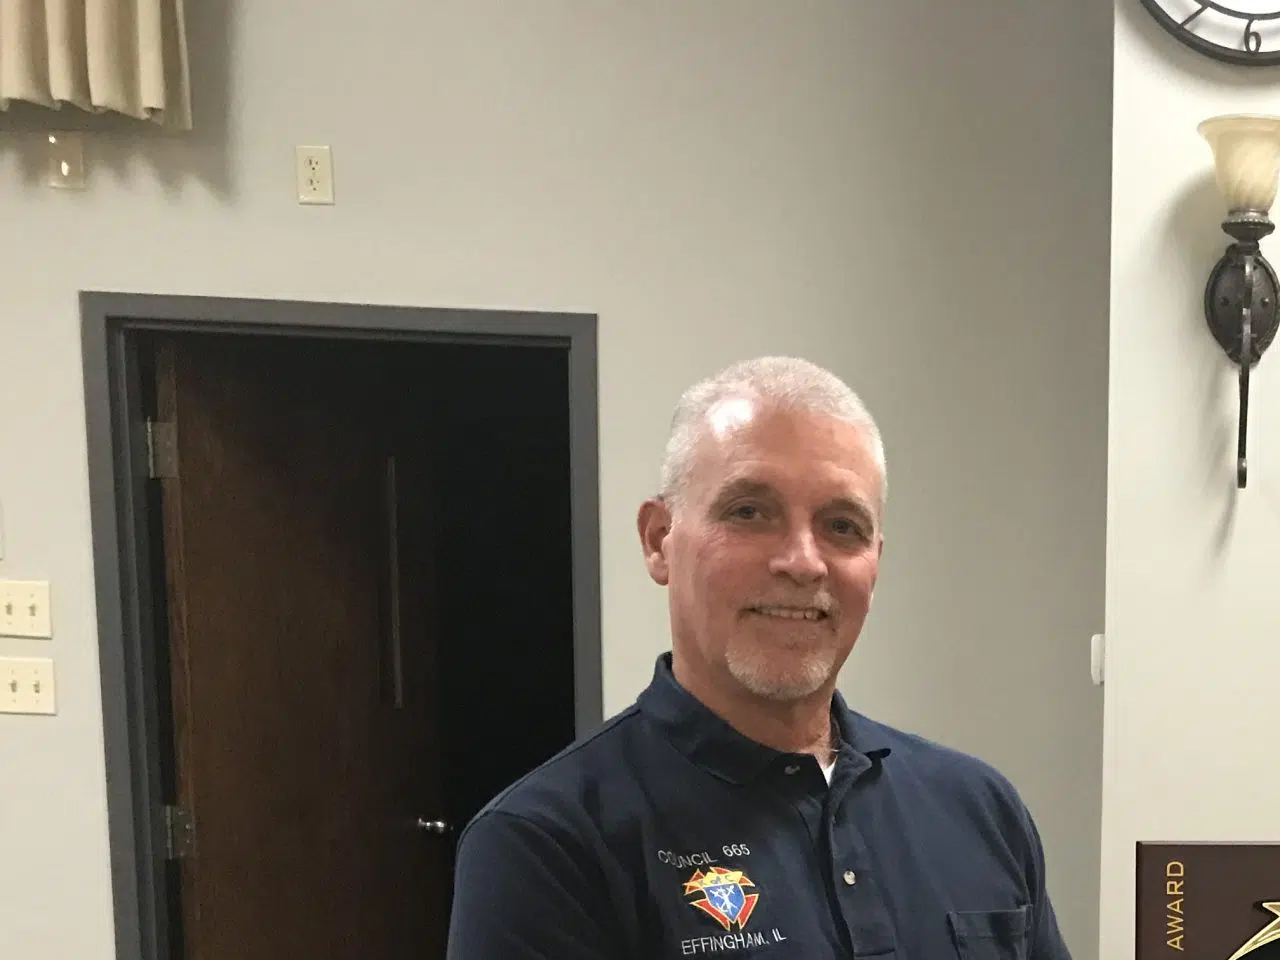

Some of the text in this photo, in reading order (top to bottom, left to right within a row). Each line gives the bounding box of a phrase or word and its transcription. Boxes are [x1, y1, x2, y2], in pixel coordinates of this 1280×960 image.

[1243, 17, 1262, 54] 6
[657, 843, 751, 869] COUNCIL 665
[1165, 859, 1186, 951] AWARD
[772, 927, 788, 943] IL
